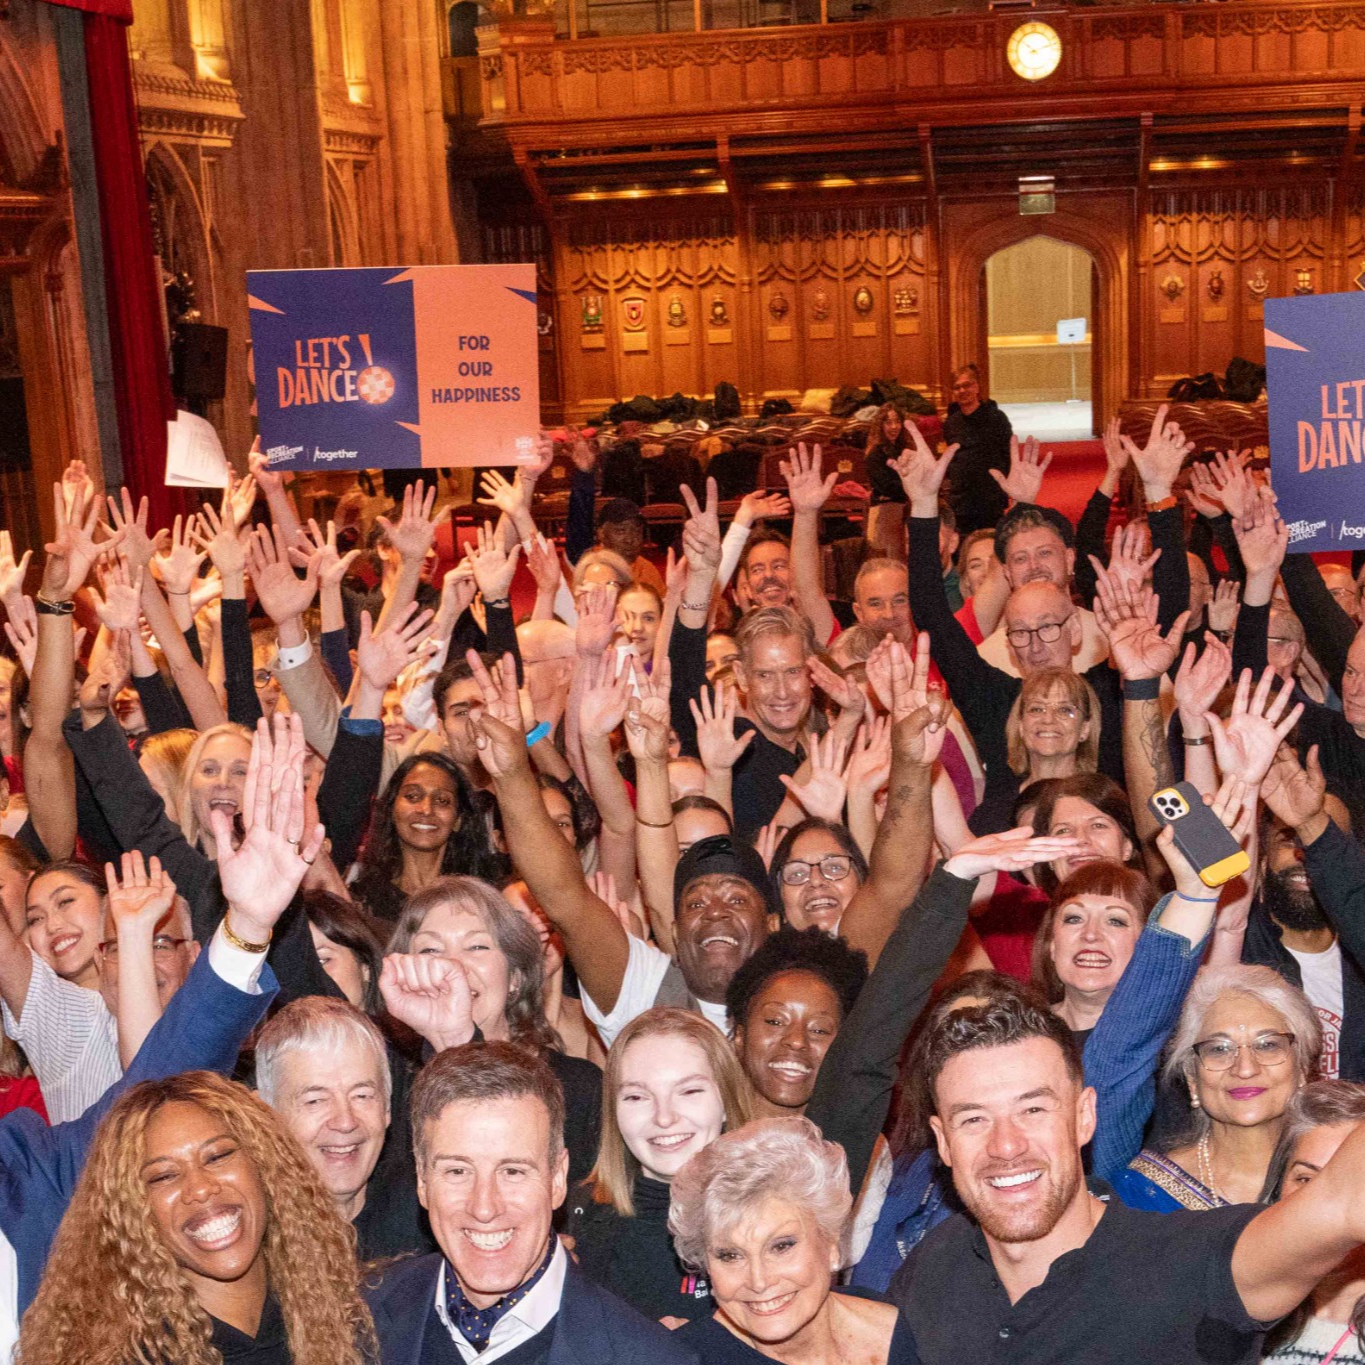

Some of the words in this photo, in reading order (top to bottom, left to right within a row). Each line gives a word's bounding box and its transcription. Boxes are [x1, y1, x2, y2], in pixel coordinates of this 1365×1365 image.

[295, 334, 352, 368] LET'S
[459, 335, 490, 351] FOR
[458, 361, 493, 378] OUR
[431, 386, 521, 404] HAPPINESS
